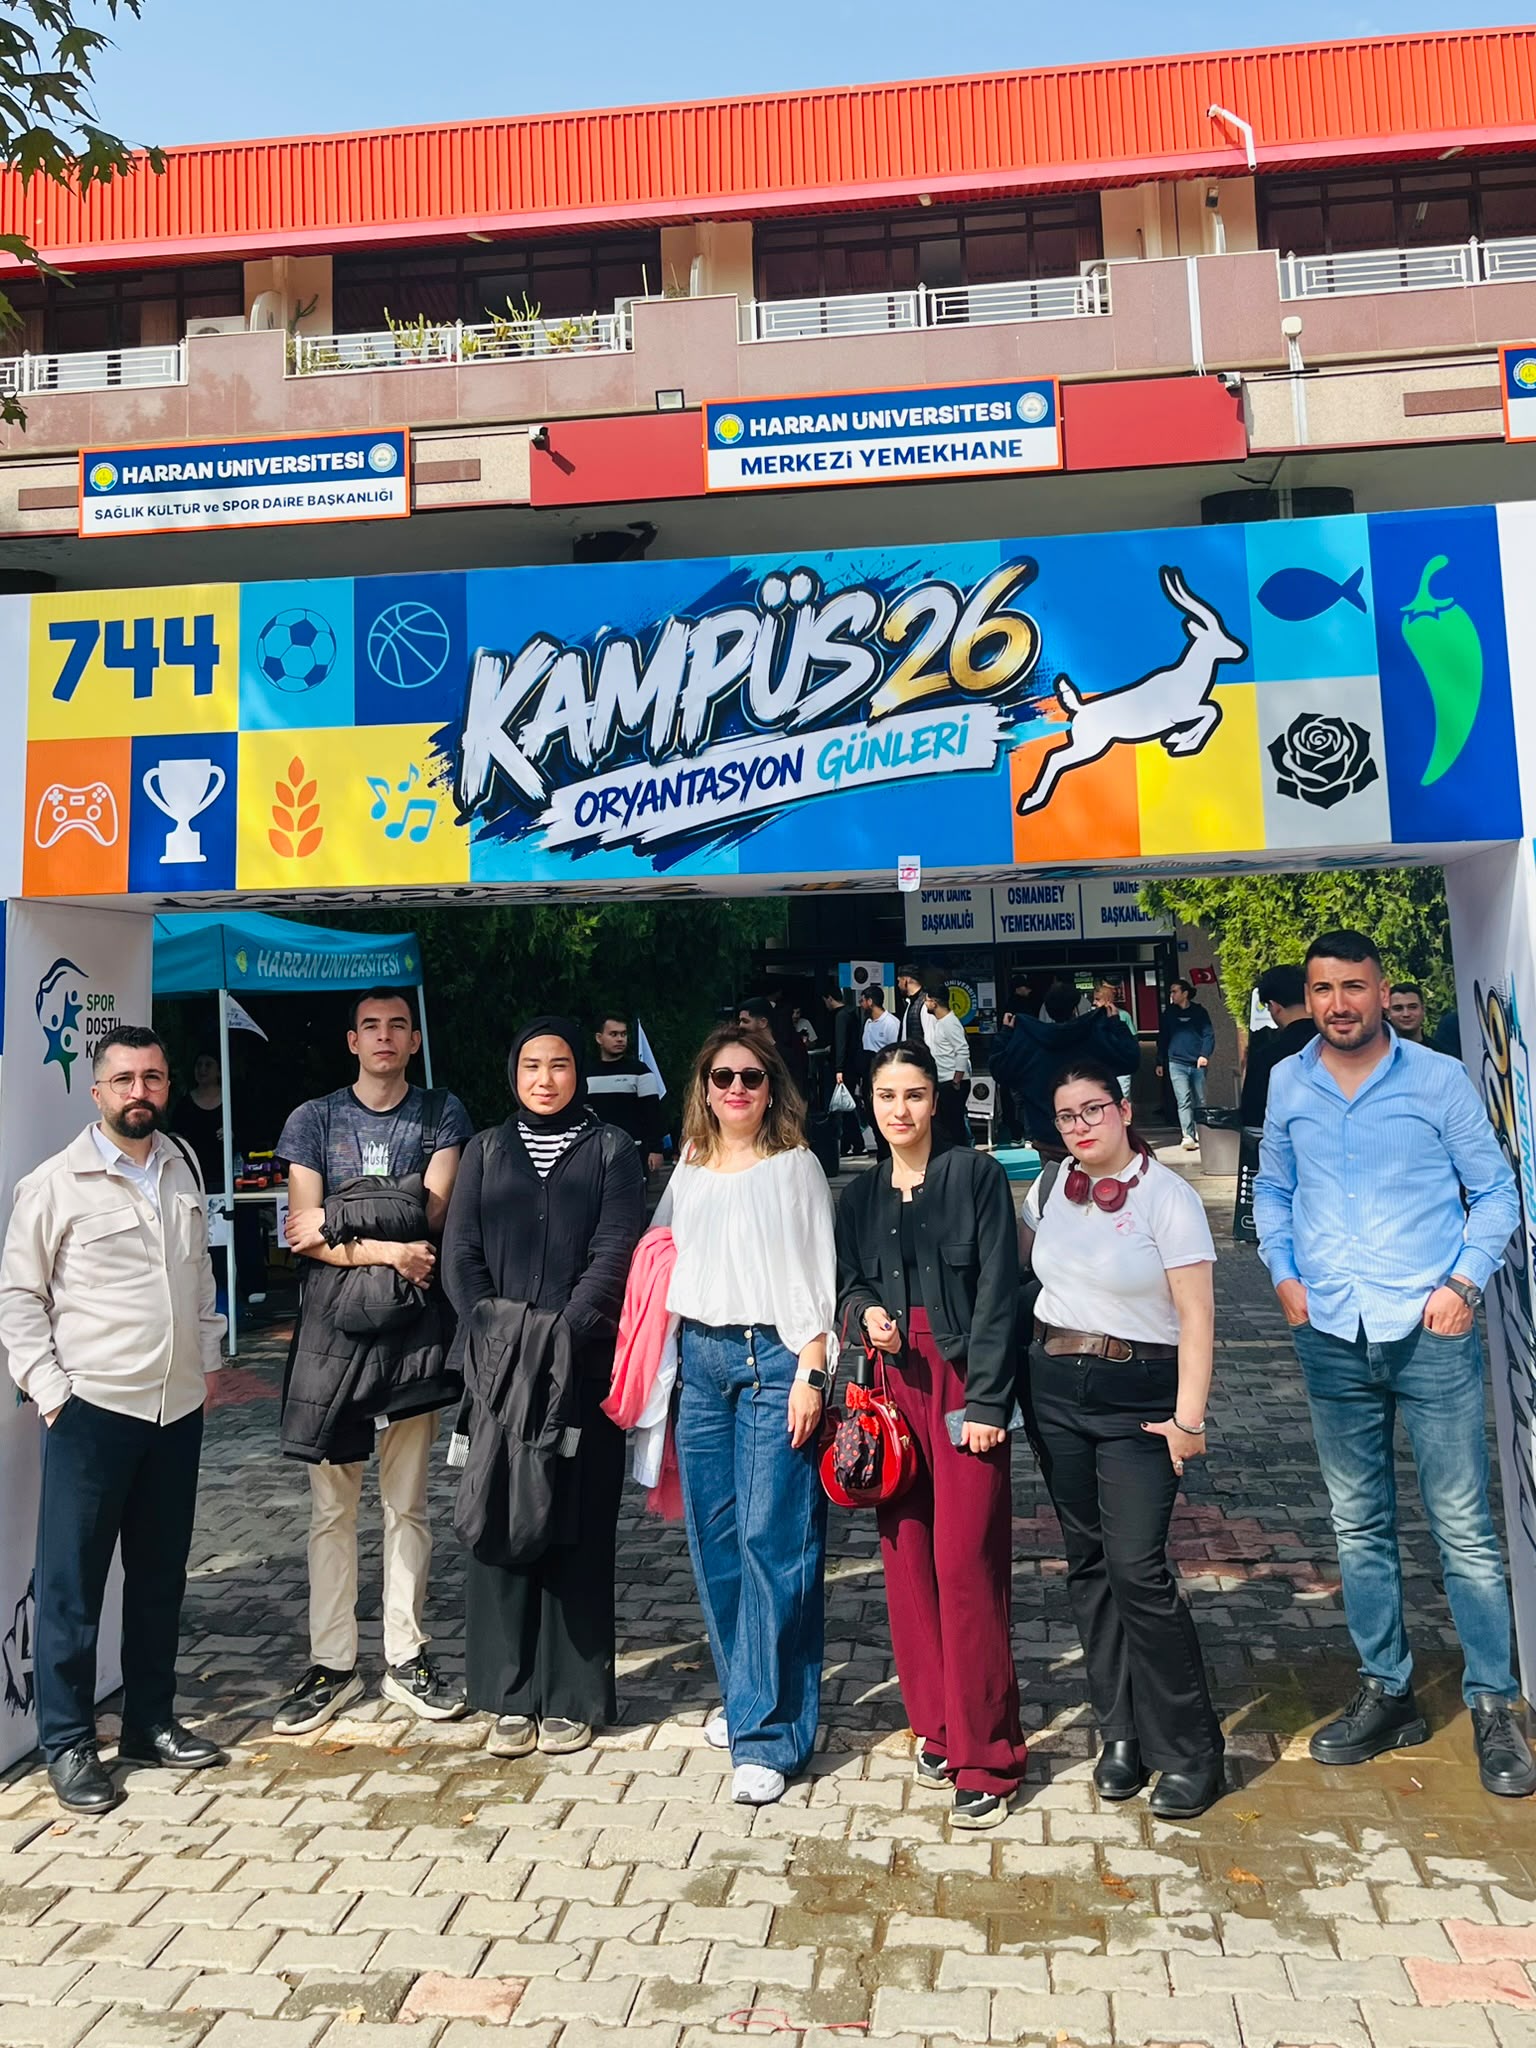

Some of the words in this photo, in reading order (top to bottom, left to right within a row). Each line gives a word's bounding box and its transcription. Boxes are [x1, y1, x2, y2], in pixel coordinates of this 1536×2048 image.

[750, 413, 849, 438] HARRAN
[740, 450, 852, 476] MERKEZİ
[859, 439, 1023, 467] YEMEKHANE
[122, 460, 214, 485] HARRAN
[94, 504, 144, 520] SAĞLIK
[147, 502, 200, 517] KÜLTÜR
[203, 503, 220, 513] ve
[222, 499, 260, 512] SPOR
[262, 495, 304, 509] DAİRE
[307, 487, 394, 507] BAŞKANLIĞI
[48, 614, 220, 702] 744
[574, 744, 805, 829] ORYANTASYON
[816, 712, 971, 790] GÜNLERİ
[1007, 885, 1065, 905] OSMANBEY
[921, 908, 974, 934] BAŞKANLIĞI
[1000, 912, 1076, 933] YEMEKHANESİ
[257, 949, 322, 979] HARRAN
[86, 993, 115, 1011] SPOR
